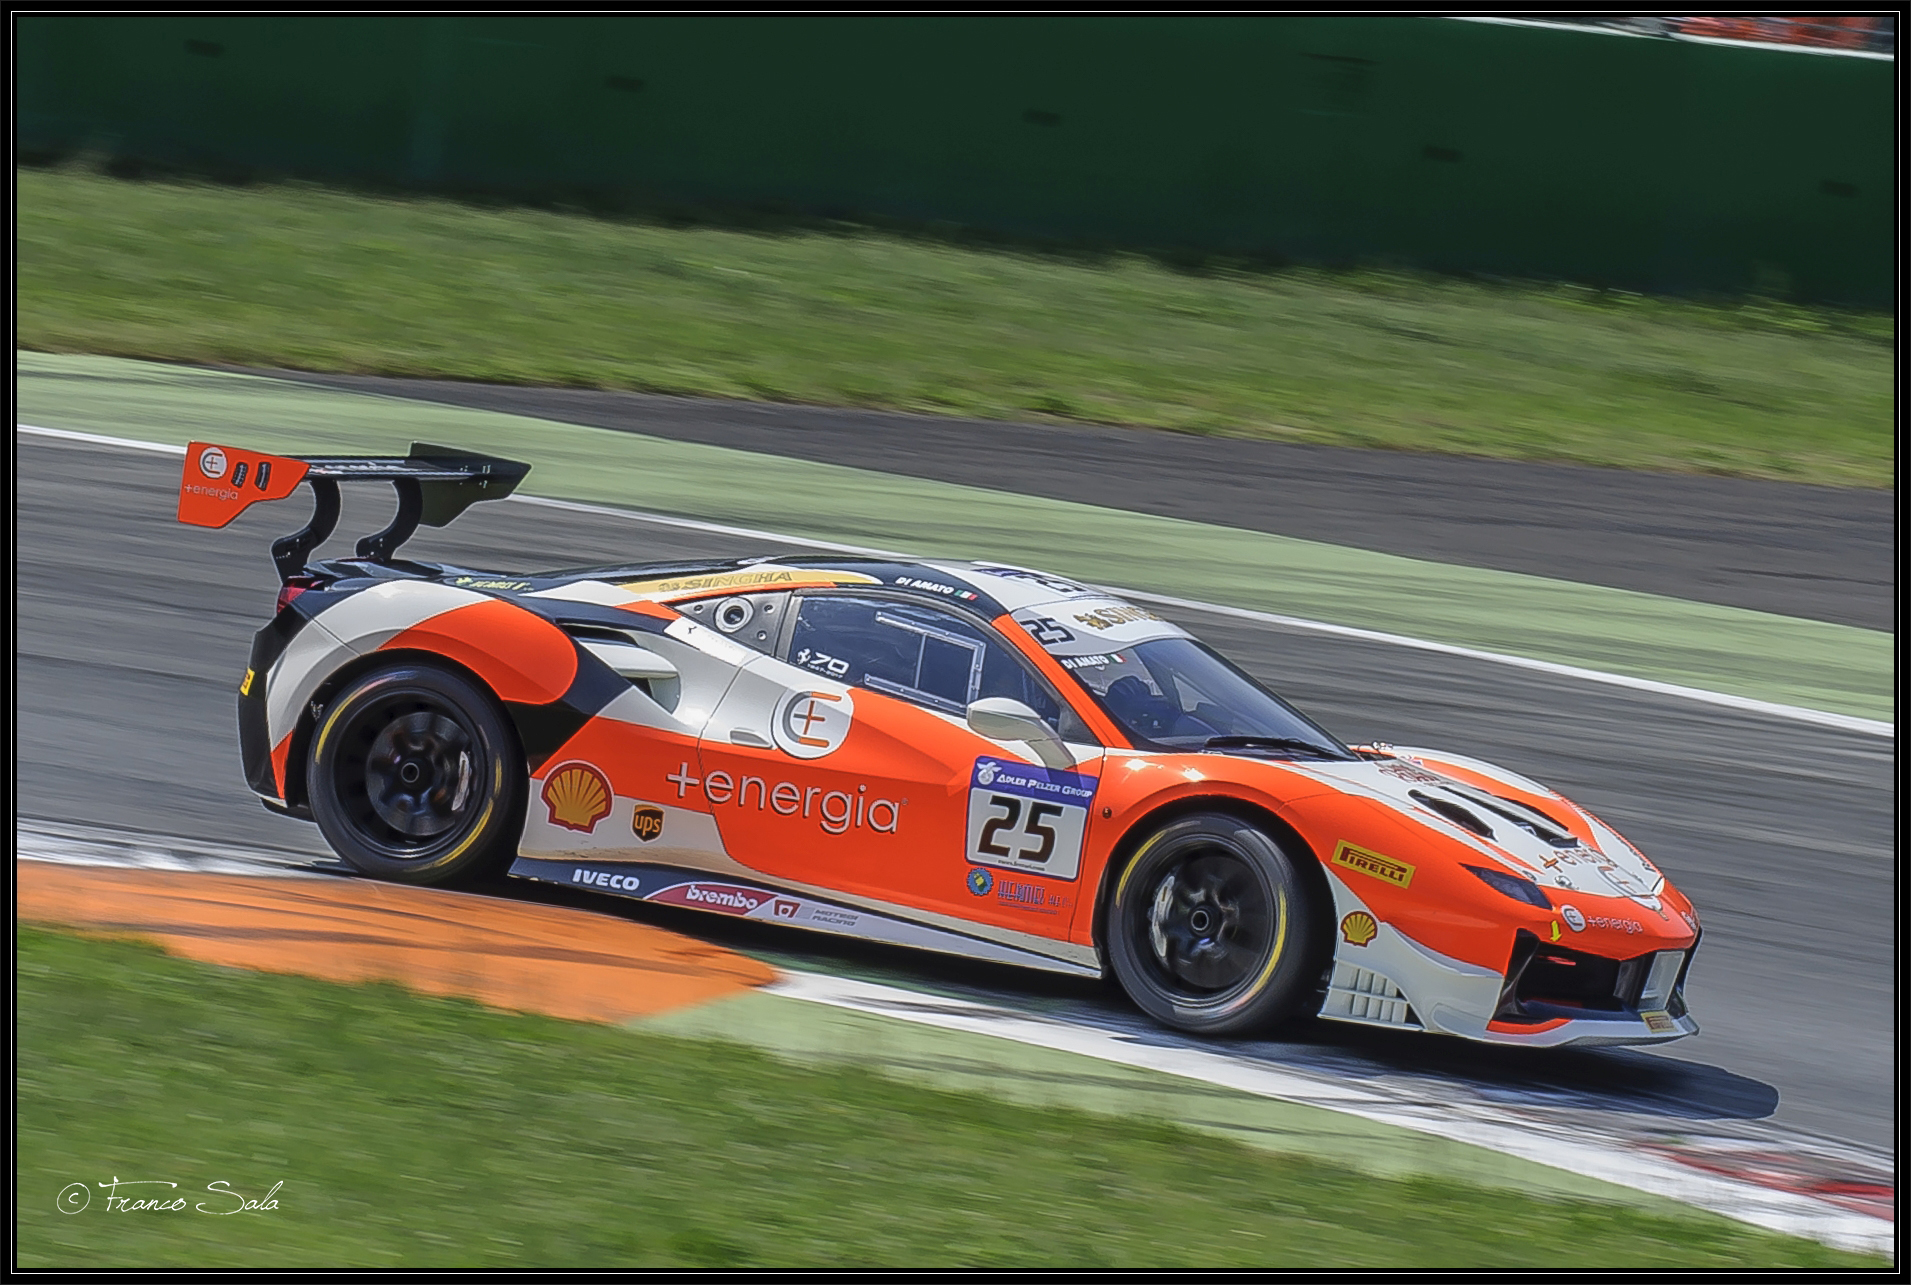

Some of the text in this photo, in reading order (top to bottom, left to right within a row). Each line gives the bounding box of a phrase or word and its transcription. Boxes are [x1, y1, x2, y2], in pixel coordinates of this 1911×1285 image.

[681, 571, 792, 590] SINGHA
[895, 577, 911, 587] DI
[911, 578, 954, 595] AMATO
[1019, 618, 1076, 645] 25
[810, 651, 850, 674] 70
[1060, 655, 1110, 670] DI AMATO
[666, 761, 900, 834] +energia
[634, 815, 662, 836] ups
[977, 795, 1064, 863] 25
[1339, 846, 1408, 882] PIRELLI
[572, 868, 641, 891] IVECO
[686, 884, 758, 910] brembo
